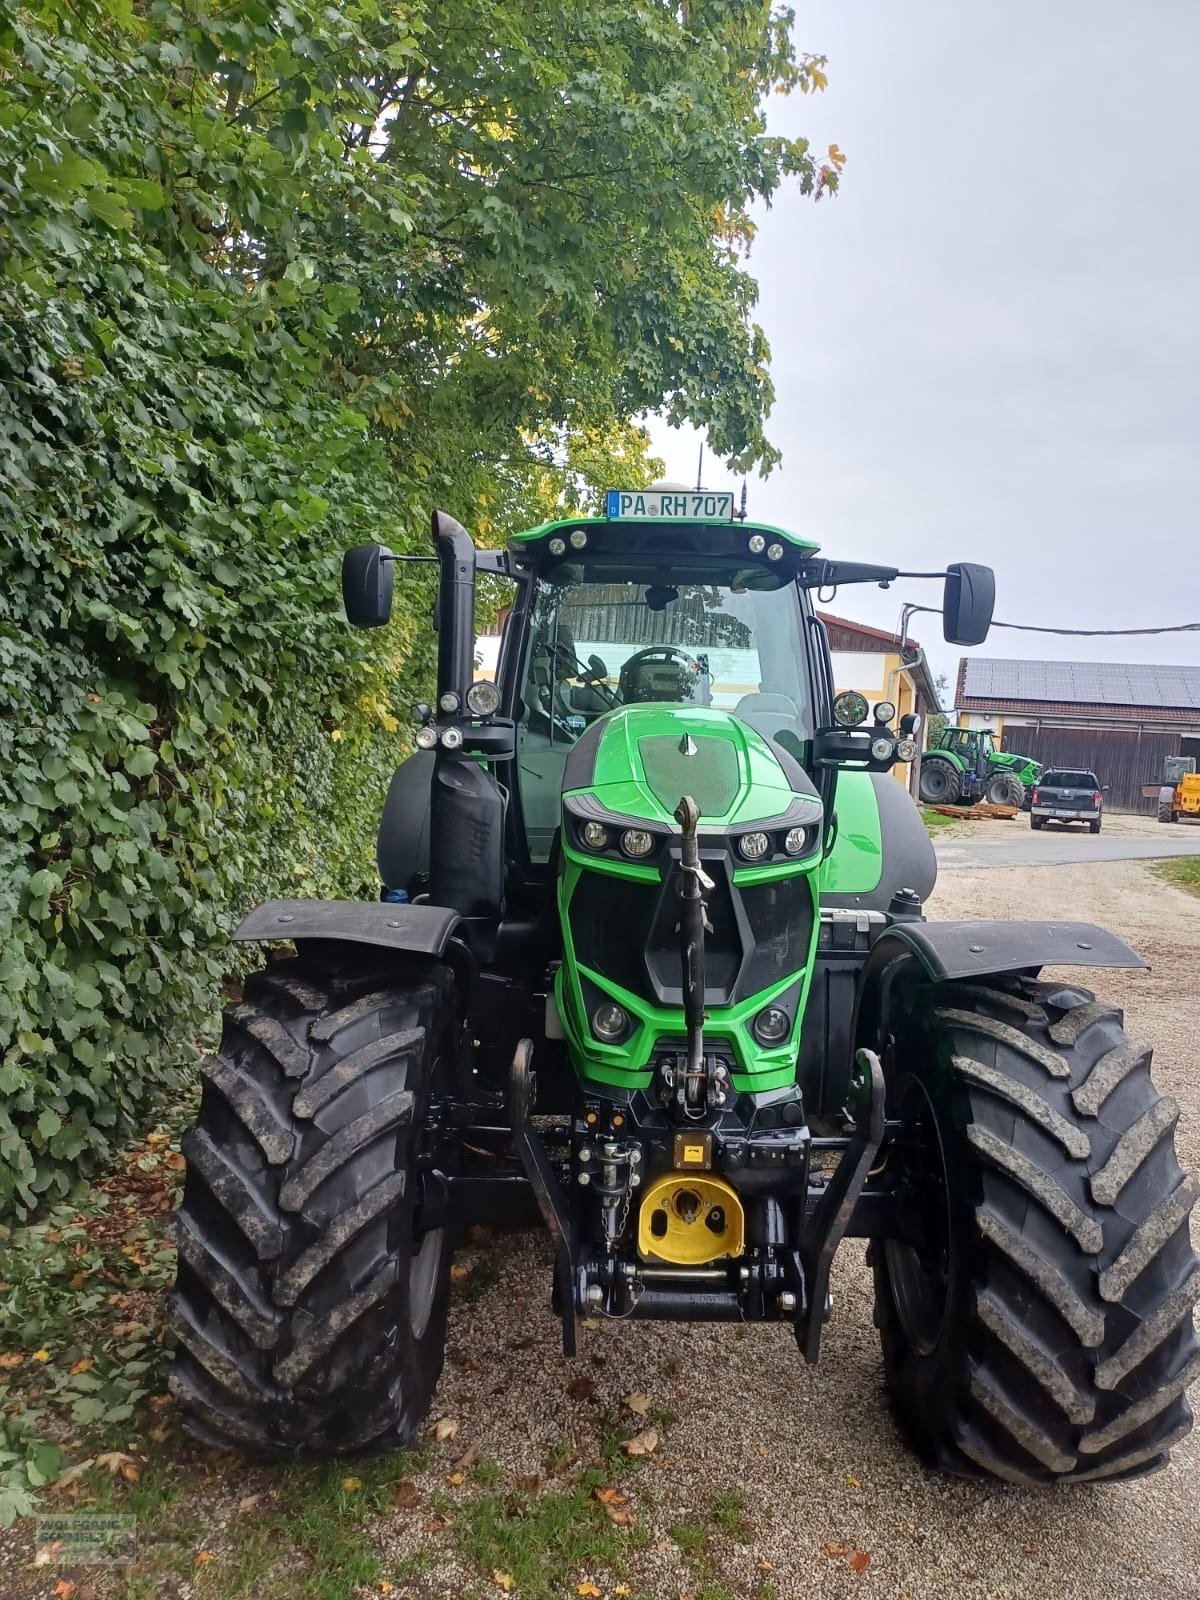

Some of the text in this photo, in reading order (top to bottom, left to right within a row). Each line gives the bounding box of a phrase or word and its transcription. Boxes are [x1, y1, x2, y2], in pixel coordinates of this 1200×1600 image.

[621, 495, 730, 517] PA RH 707
